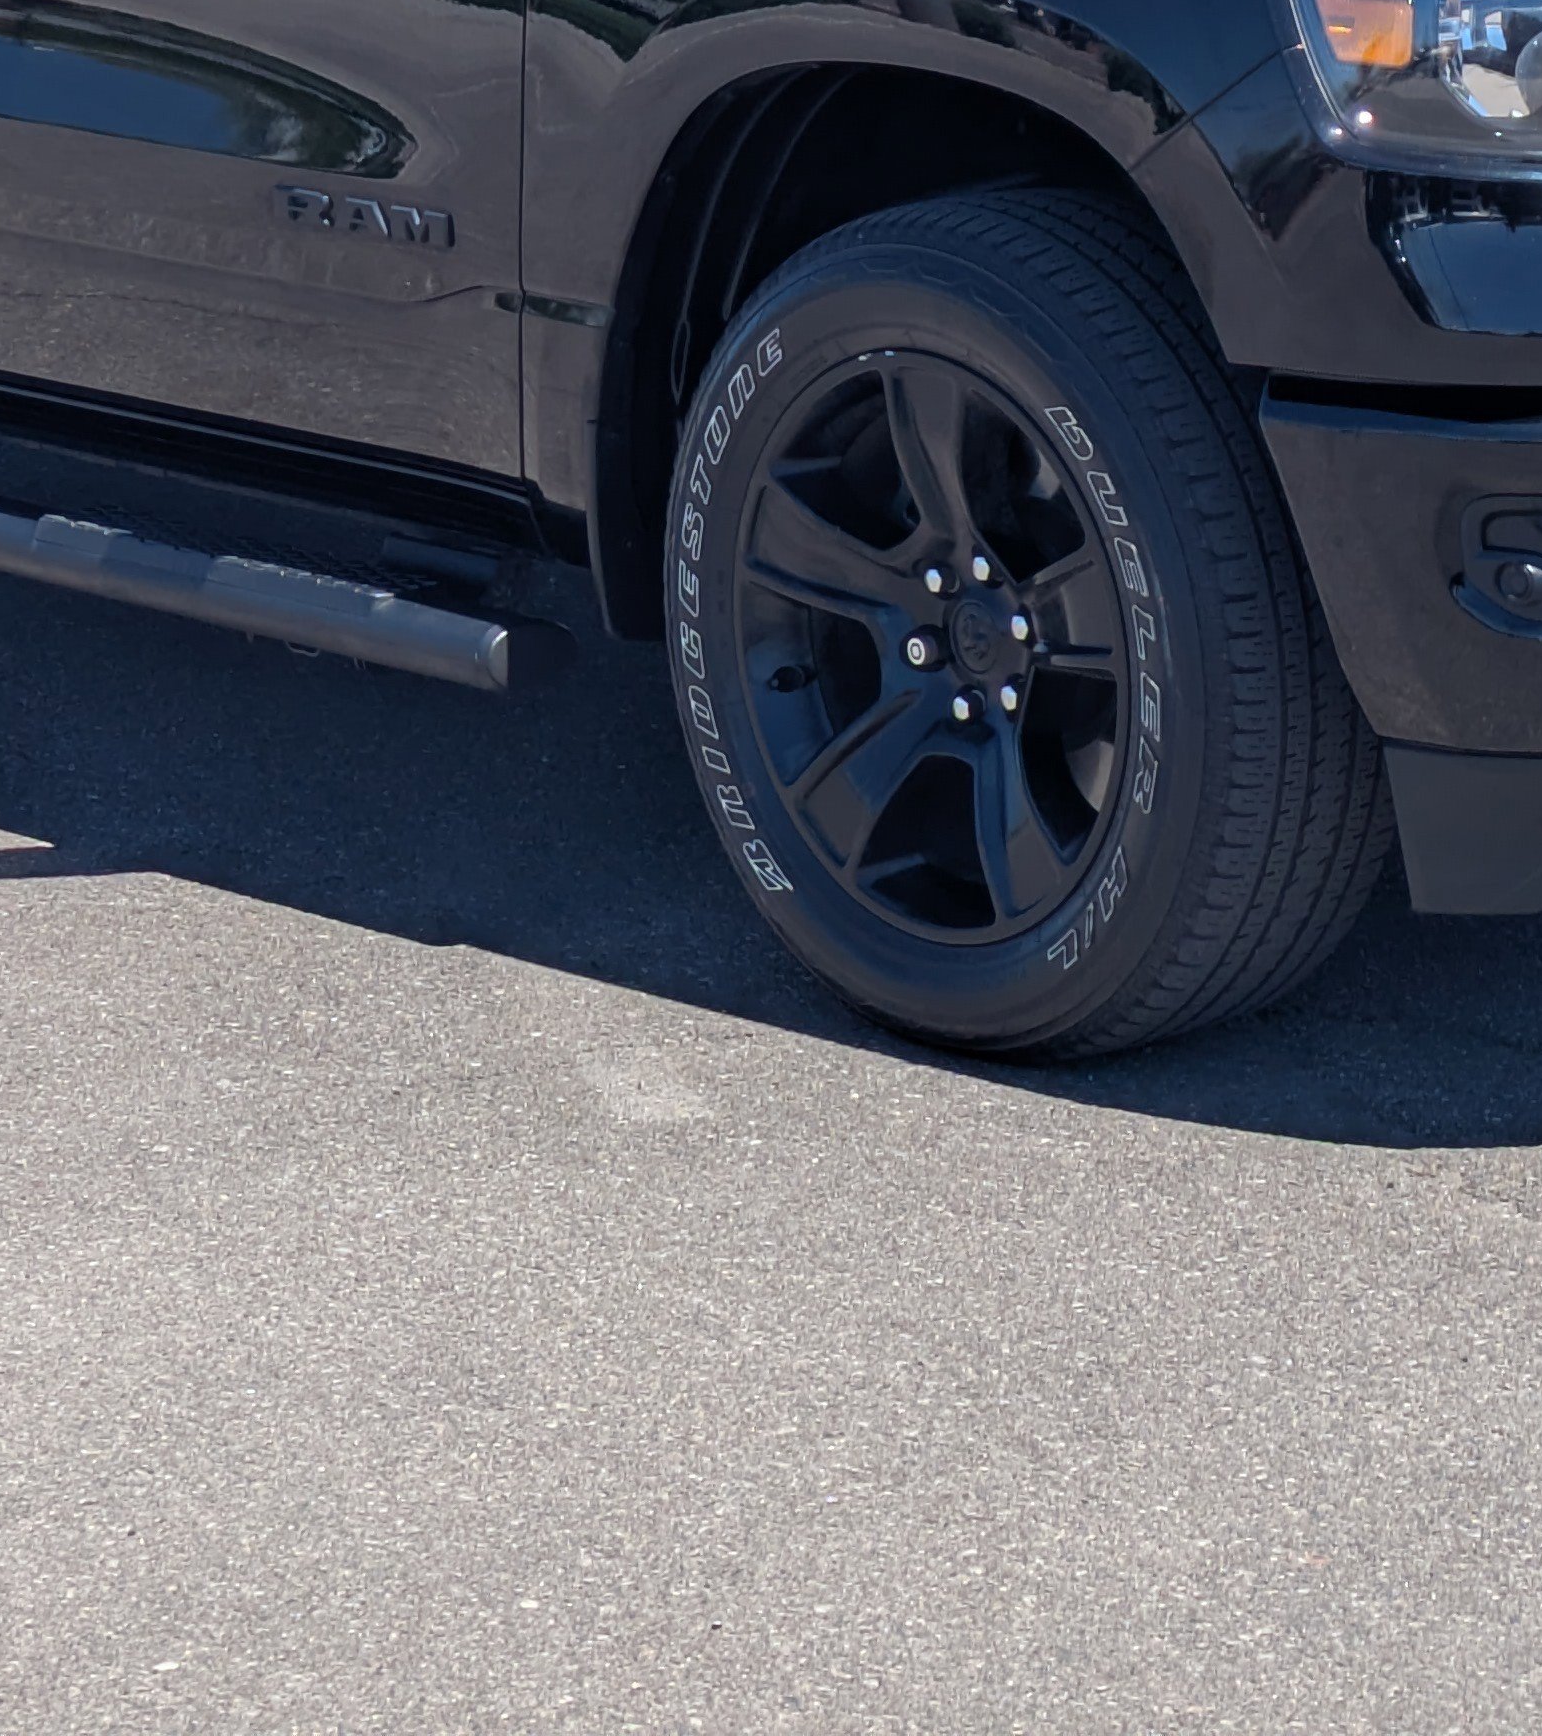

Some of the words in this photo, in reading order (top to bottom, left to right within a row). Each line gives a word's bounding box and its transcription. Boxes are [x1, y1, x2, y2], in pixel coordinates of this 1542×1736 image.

[272, 183, 457, 250] RAM
[676, 327, 794, 894] BRIDGESTONE
[1044, 404, 1163, 816] DUELER
